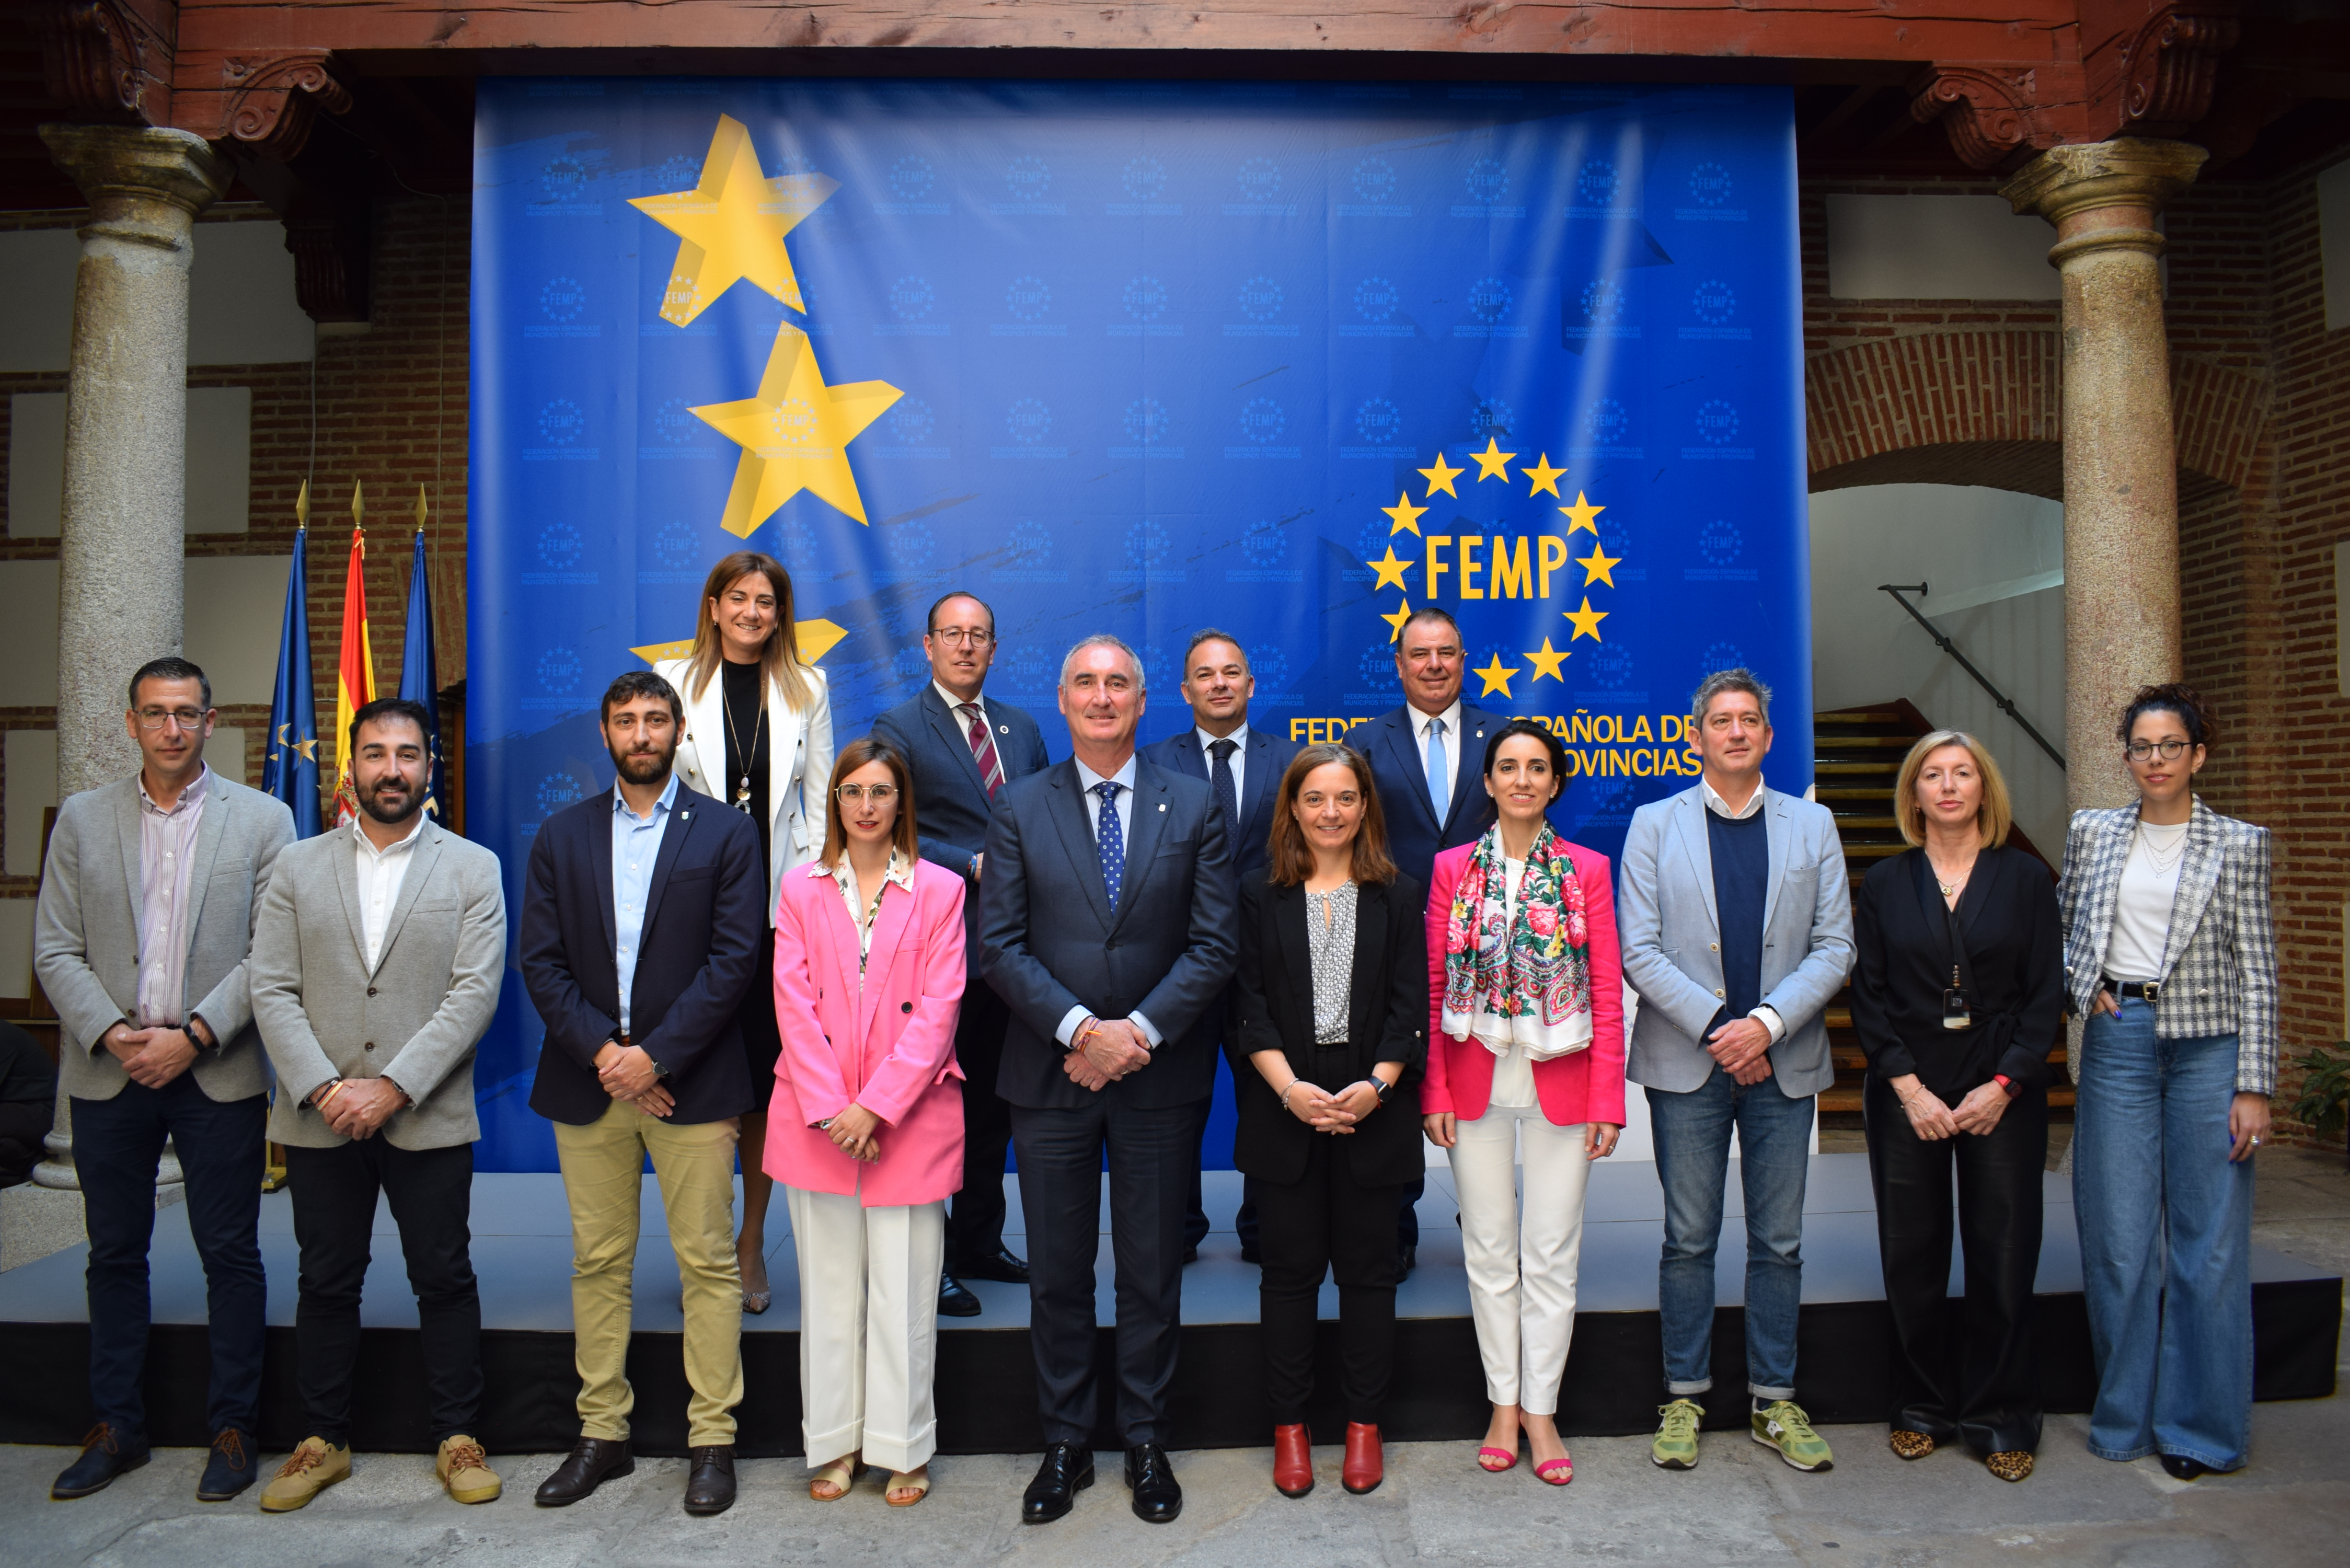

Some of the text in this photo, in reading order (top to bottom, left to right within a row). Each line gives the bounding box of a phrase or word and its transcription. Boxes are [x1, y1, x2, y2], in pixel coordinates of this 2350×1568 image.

[552, 172, 578, 184] FEMP
[667, 171, 694, 183] FEMP
[900, 171, 926, 183] FEMP
[1016, 171, 1042, 183] FEMP
[1131, 171, 1157, 183] FEMP
[1247, 172, 1273, 184] FEMP
[1361, 173, 1387, 185] FEMP
[1475, 174, 1501, 186] FEMP
[1587, 176, 1612, 188] FEMP
[1698, 178, 1724, 189] FEMP
[549, 293, 576, 305] FEMP
[665, 292, 692, 304] FEMP
[899, 291, 925, 303] FEMP
[1015, 292, 1042, 304] FEMP
[1133, 292, 1159, 304] FEMP
[1248, 292, 1274, 304] FEMP
[1363, 293, 1389, 305] FEMP
[1478, 293, 1504, 305] FEMP
[1590, 295, 1616, 307] FEMP
[1702, 296, 1727, 307] FEMP
[548, 416, 575, 428] FEMP
[665, 414, 692, 426] FEMP
[781, 414, 808, 426] FEMP
[899, 414, 925, 426] FEMP
[1016, 414, 1042, 426] FEMP
[1133, 414, 1159, 426] FEMP
[1250, 414, 1276, 426] FEMP
[1365, 414, 1391, 426] FEMP
[1480, 414, 1506, 426] FEMP
[1593, 414, 1619, 426] FEMP
[1705, 416, 1731, 428] FEMP
[547, 539, 574, 551] FEMP
[664, 539, 690, 551] FEMP
[781, 538, 808, 550] FEMP
[899, 537, 926, 550] FEMP
[1016, 538, 1043, 550] FEMP
[1134, 538, 1160, 550] FEMP
[1251, 537, 1277, 549] FEMP
[1367, 536, 1393, 548] FEMP
[1708, 536, 1734, 548] FEMP
[1426, 535, 1568, 599] FEMP
[546, 664, 573, 676] FEMP
[900, 662, 926, 674] FEMP
[1017, 662, 1044, 674] FEMP
[1252, 661, 1278, 673] FEMP
[1369, 660, 1395, 672] FEMP
[1598, 659, 1624, 671] FEMP
[1505, 709, 1654, 743] AÑOLA
[1564, 748, 1702, 777] OVINCIAS
[1600, 782, 1626, 794] FEMP
[547, 789, 573, 802] FEMP
